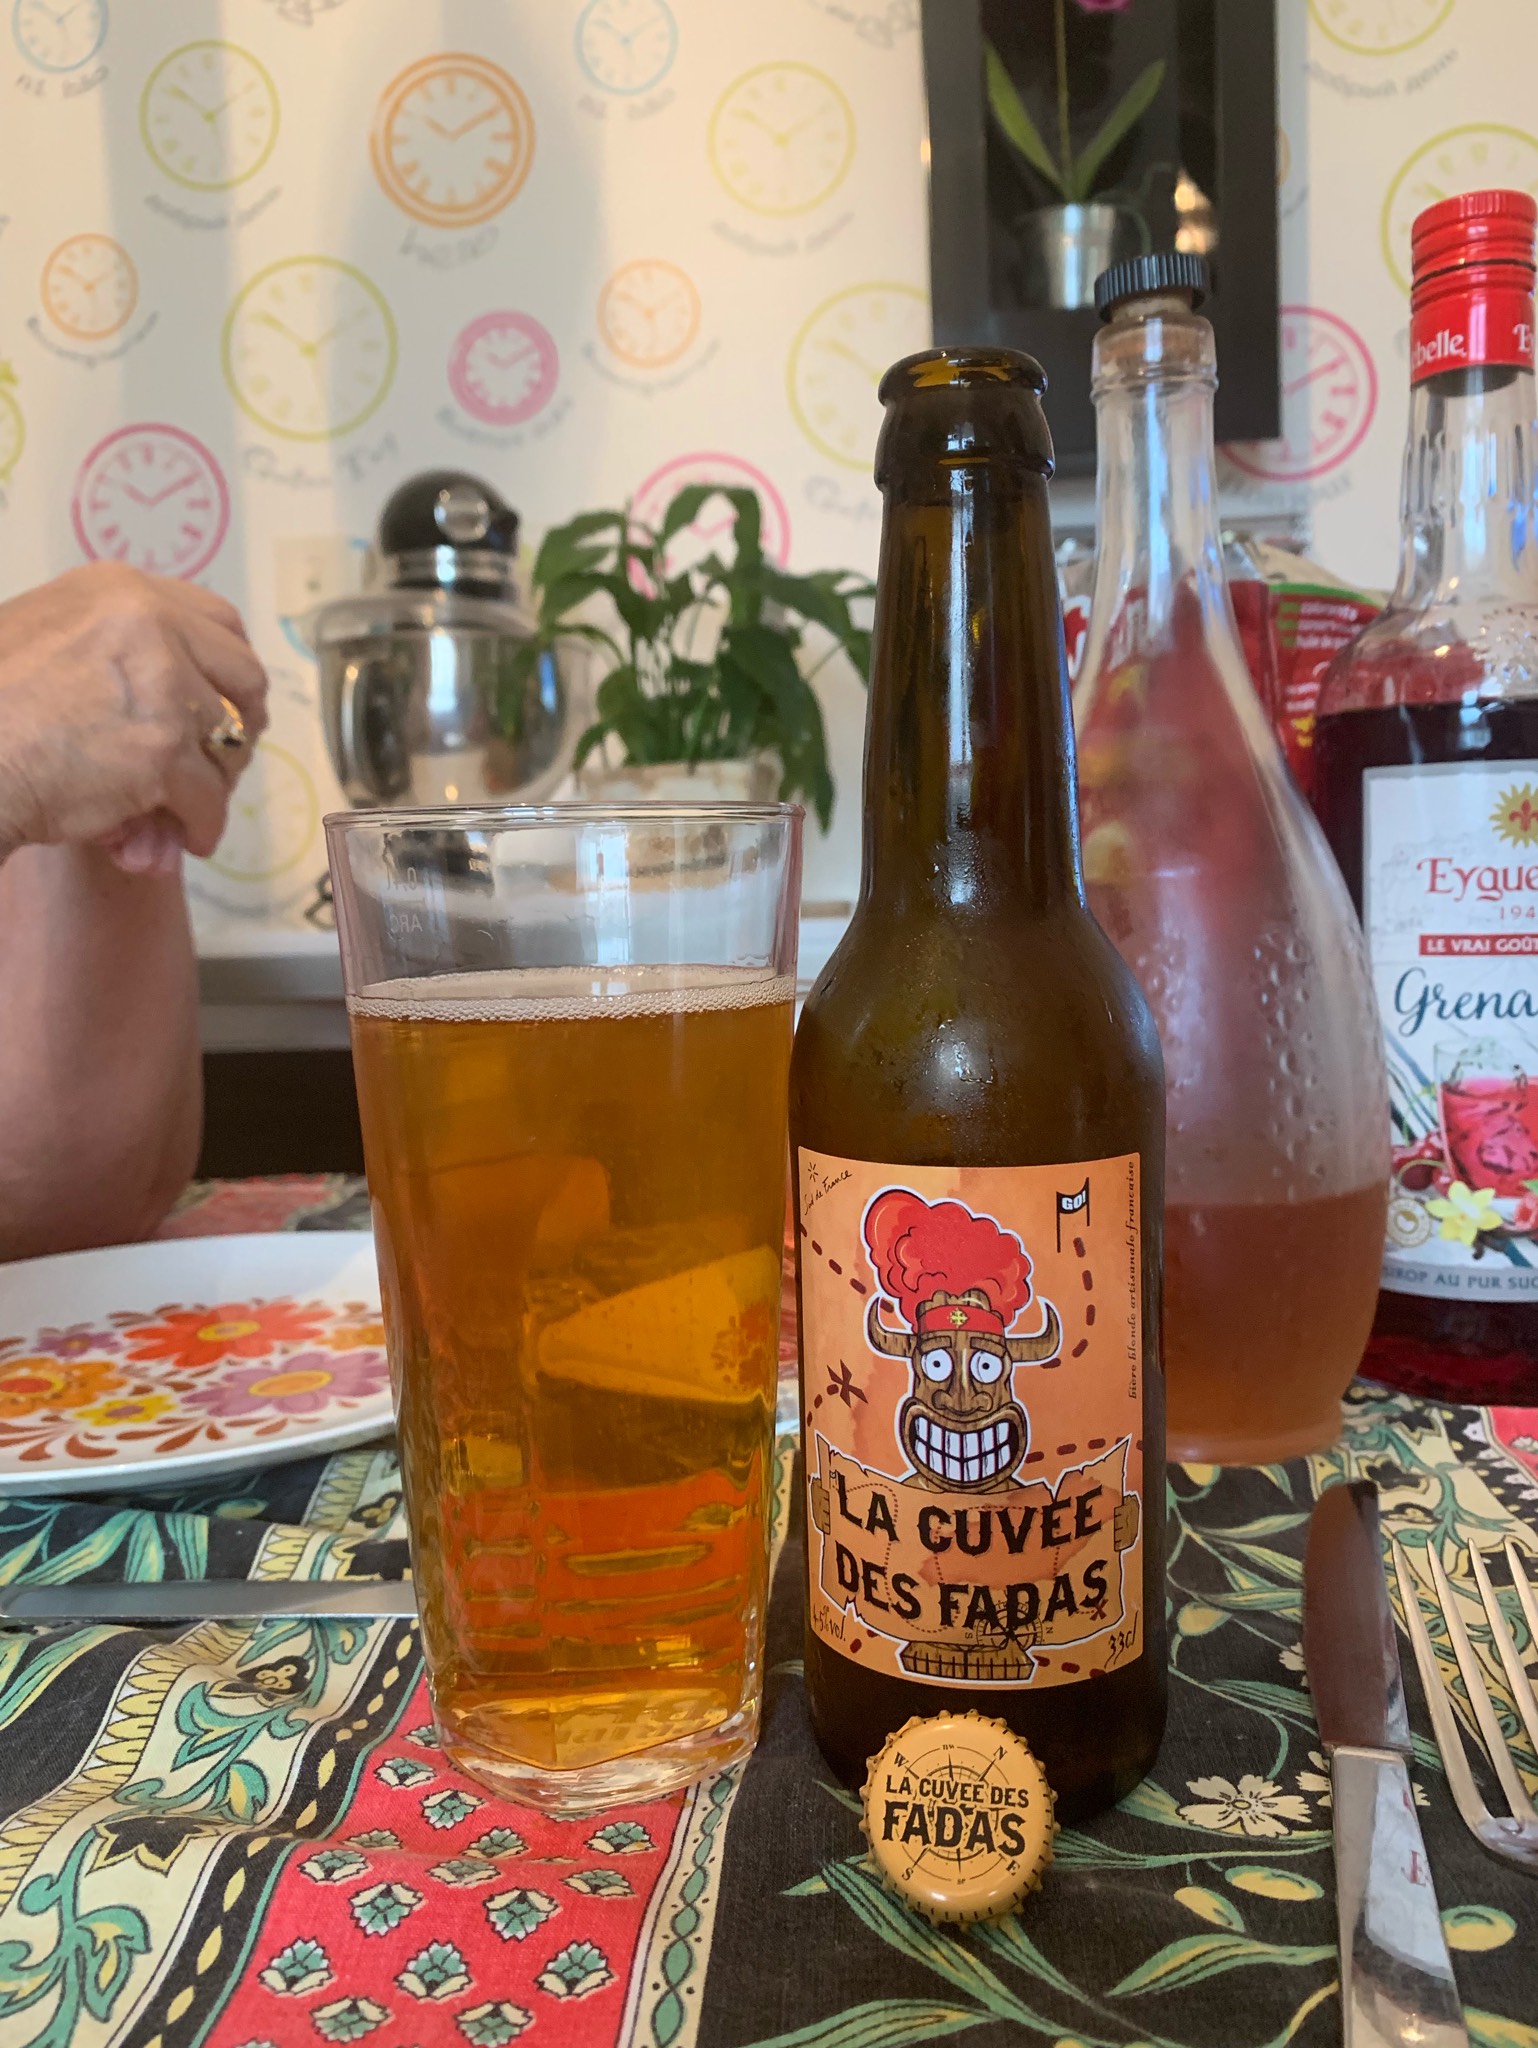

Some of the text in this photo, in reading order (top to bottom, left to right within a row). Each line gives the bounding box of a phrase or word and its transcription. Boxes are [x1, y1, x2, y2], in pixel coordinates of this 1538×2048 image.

[1426, 938, 1446, 953] LE
[1451, 938, 1491, 953] VRAI
[1394, 966, 1538, 1037] Grena
[822, 1169, 853, 1194] France
[1061, 1189, 1087, 1211] GO!
[1126, 1235, 1136, 1309] artisanale
[1434, 1272, 1460, 1287] AU
[1467, 1275, 1503, 1290] PUR
[1127, 1313, 1137, 1361] blonde
[836, 1472, 899, 1542] LA
[835, 1540, 1109, 1632] DES FADAS
[893, 1751, 909, 1769] W
[992, 1745, 1008, 1761] N
[885, 1774, 1030, 1809] LA CUVEE DES
[881, 1799, 1027, 1857] FADAS
[901, 1867, 914, 1881] S
[1005, 1859, 1021, 1876] E
